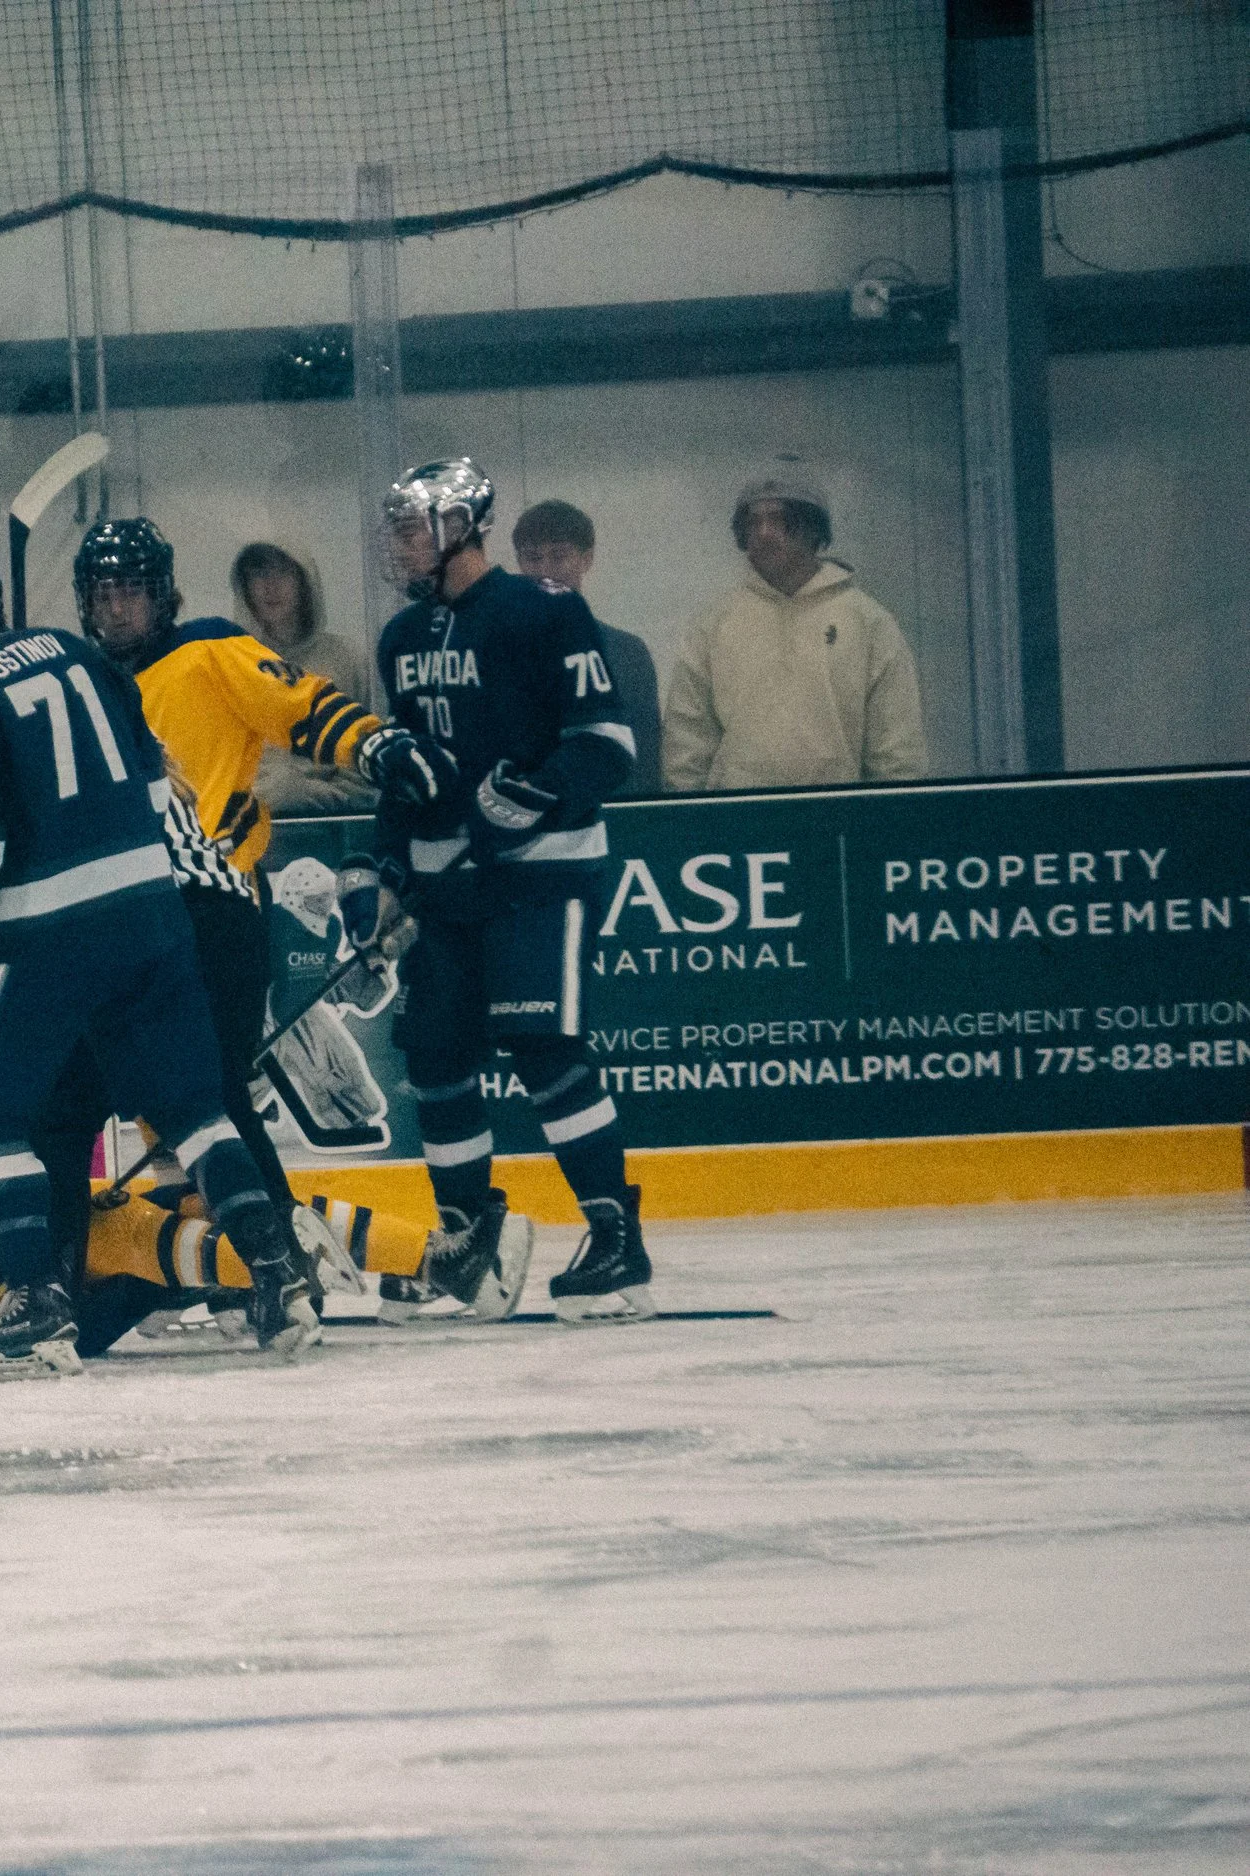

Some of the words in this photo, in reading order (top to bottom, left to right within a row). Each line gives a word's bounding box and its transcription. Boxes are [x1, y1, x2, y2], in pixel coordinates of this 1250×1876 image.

[563, 650, 613, 698] 70
[4, 663, 129, 800] 71
[416, 695, 454, 739] 70
[884, 847, 1168, 893] PROPERTY
[599, 851, 803, 937] ASE
[592, 941, 808, 977] NATIONAL
[587, 1027, 671, 1052] RVICE
[681, 1018, 848, 1049] PROPERTY
[858, 1006, 1086, 1042] MANAGEMENT
[1095, 1000, 1250, 1031] SOLUTION
[1035, 1039, 1250, 1075] 775-828-REN
